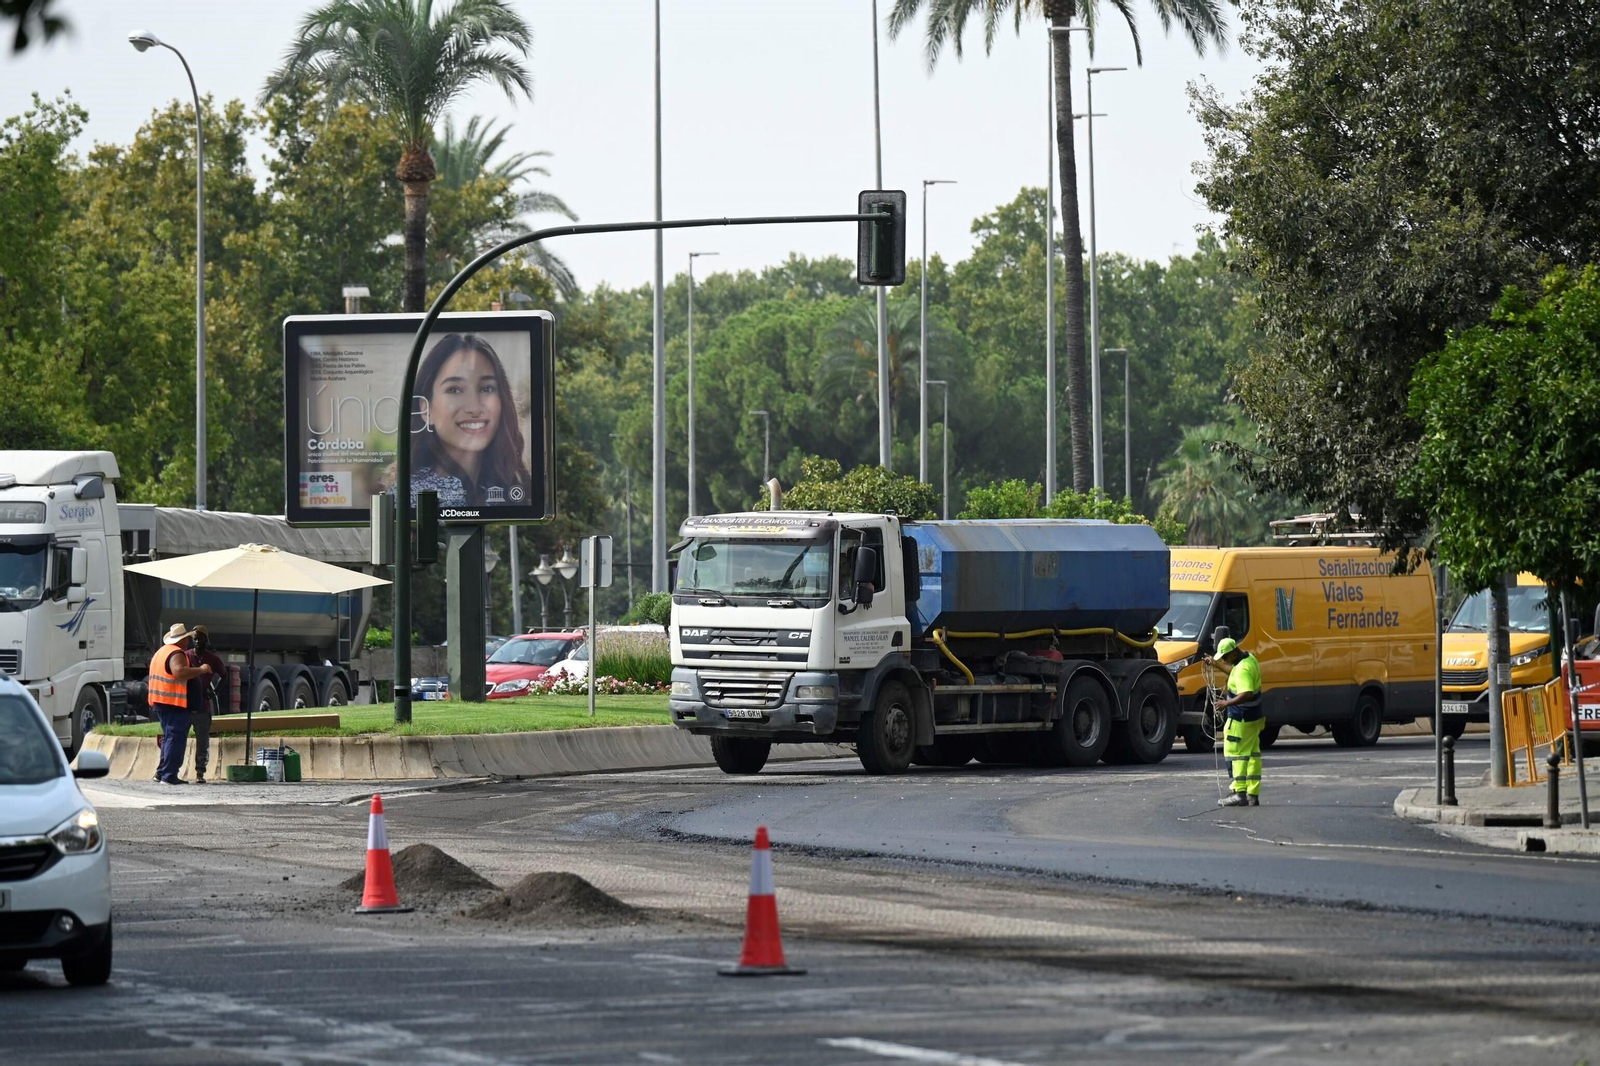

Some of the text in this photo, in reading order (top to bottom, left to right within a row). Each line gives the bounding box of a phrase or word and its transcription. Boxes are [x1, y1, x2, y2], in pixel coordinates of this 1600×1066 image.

[307, 384, 433, 434] única
[308, 437, 364, 450] Córdoba
[309, 474, 335, 483] eres
[310, 482, 339, 496] patri
[309, 494, 347, 505] monio
[0, 507, 39, 519] TER
[60, 502, 95, 522] Sergio
[440, 509, 480, 517] JCDecaux
[753, 518, 807, 526] EXCAVACIONES
[728, 525, 788, 535] CALERO
[1322, 581, 1364, 603] Viales
[1327, 606, 1399, 630] Fernández
[682, 629, 708, 637] DAF
[1446, 657, 1477, 666] IVECO
[1442, 704, 1454, 712] 234
